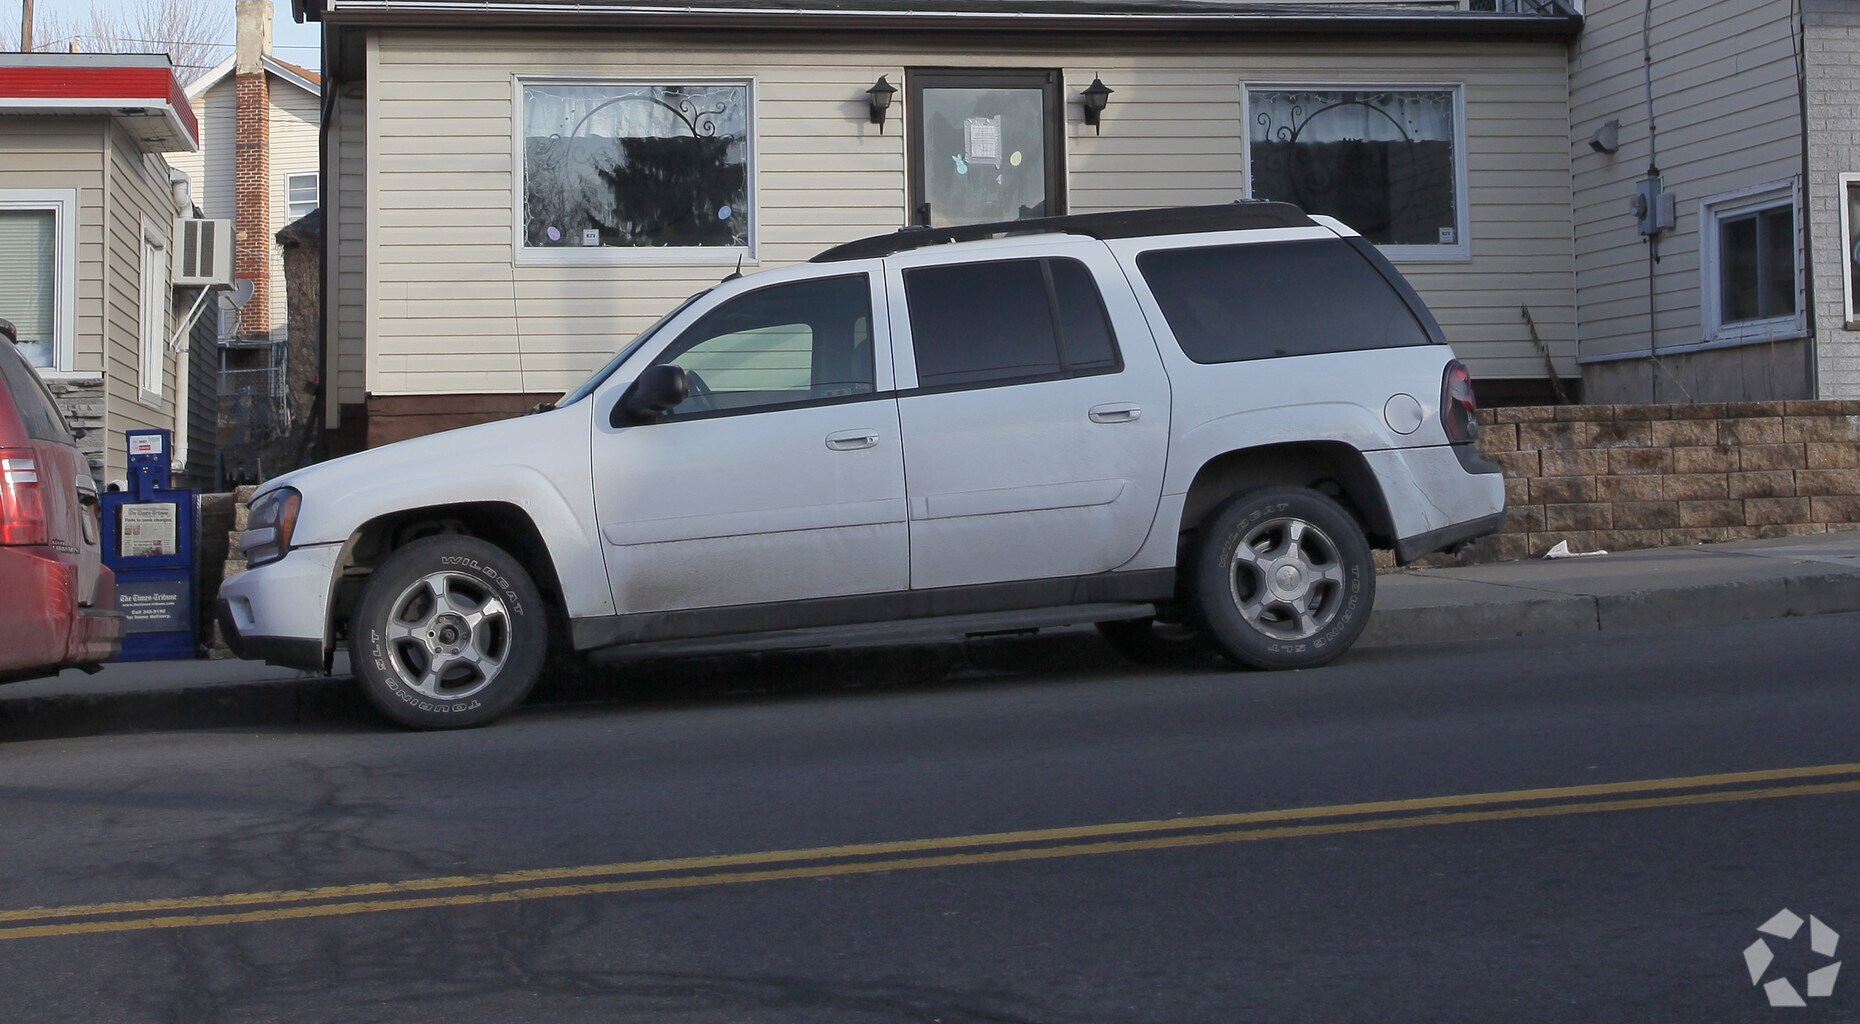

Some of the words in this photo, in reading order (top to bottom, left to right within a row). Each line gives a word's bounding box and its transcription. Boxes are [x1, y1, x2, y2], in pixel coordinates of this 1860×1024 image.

[1218, 503, 1289, 569] WILDCAT
[120, 594, 132, 602] The
[441, 556, 524, 616] WILDCAT
[1313, 565, 1360, 648] TOURING
[371, 629, 386, 671] SLT
[1267, 644, 1306, 654] SLT
[385, 677, 482, 713] TOURING
